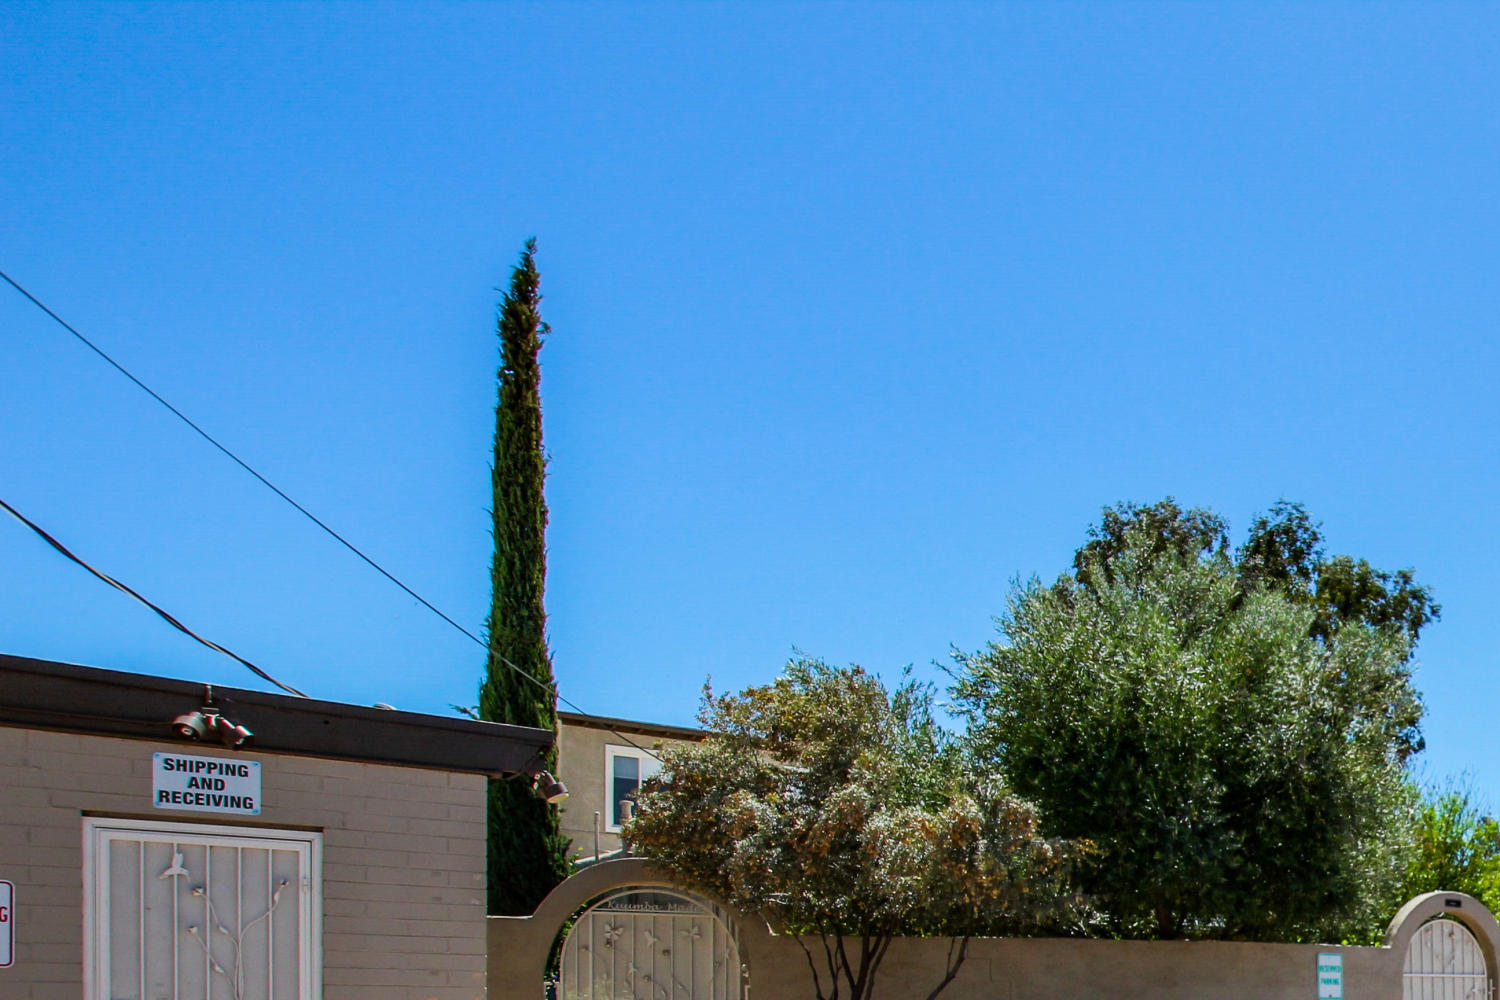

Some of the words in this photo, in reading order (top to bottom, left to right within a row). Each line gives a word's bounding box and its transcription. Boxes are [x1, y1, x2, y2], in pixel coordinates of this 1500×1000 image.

[162, 757, 249, 778] SHIPPING
[187, 776, 226, 791] AND
[157, 789, 254, 810] RECEIVING
